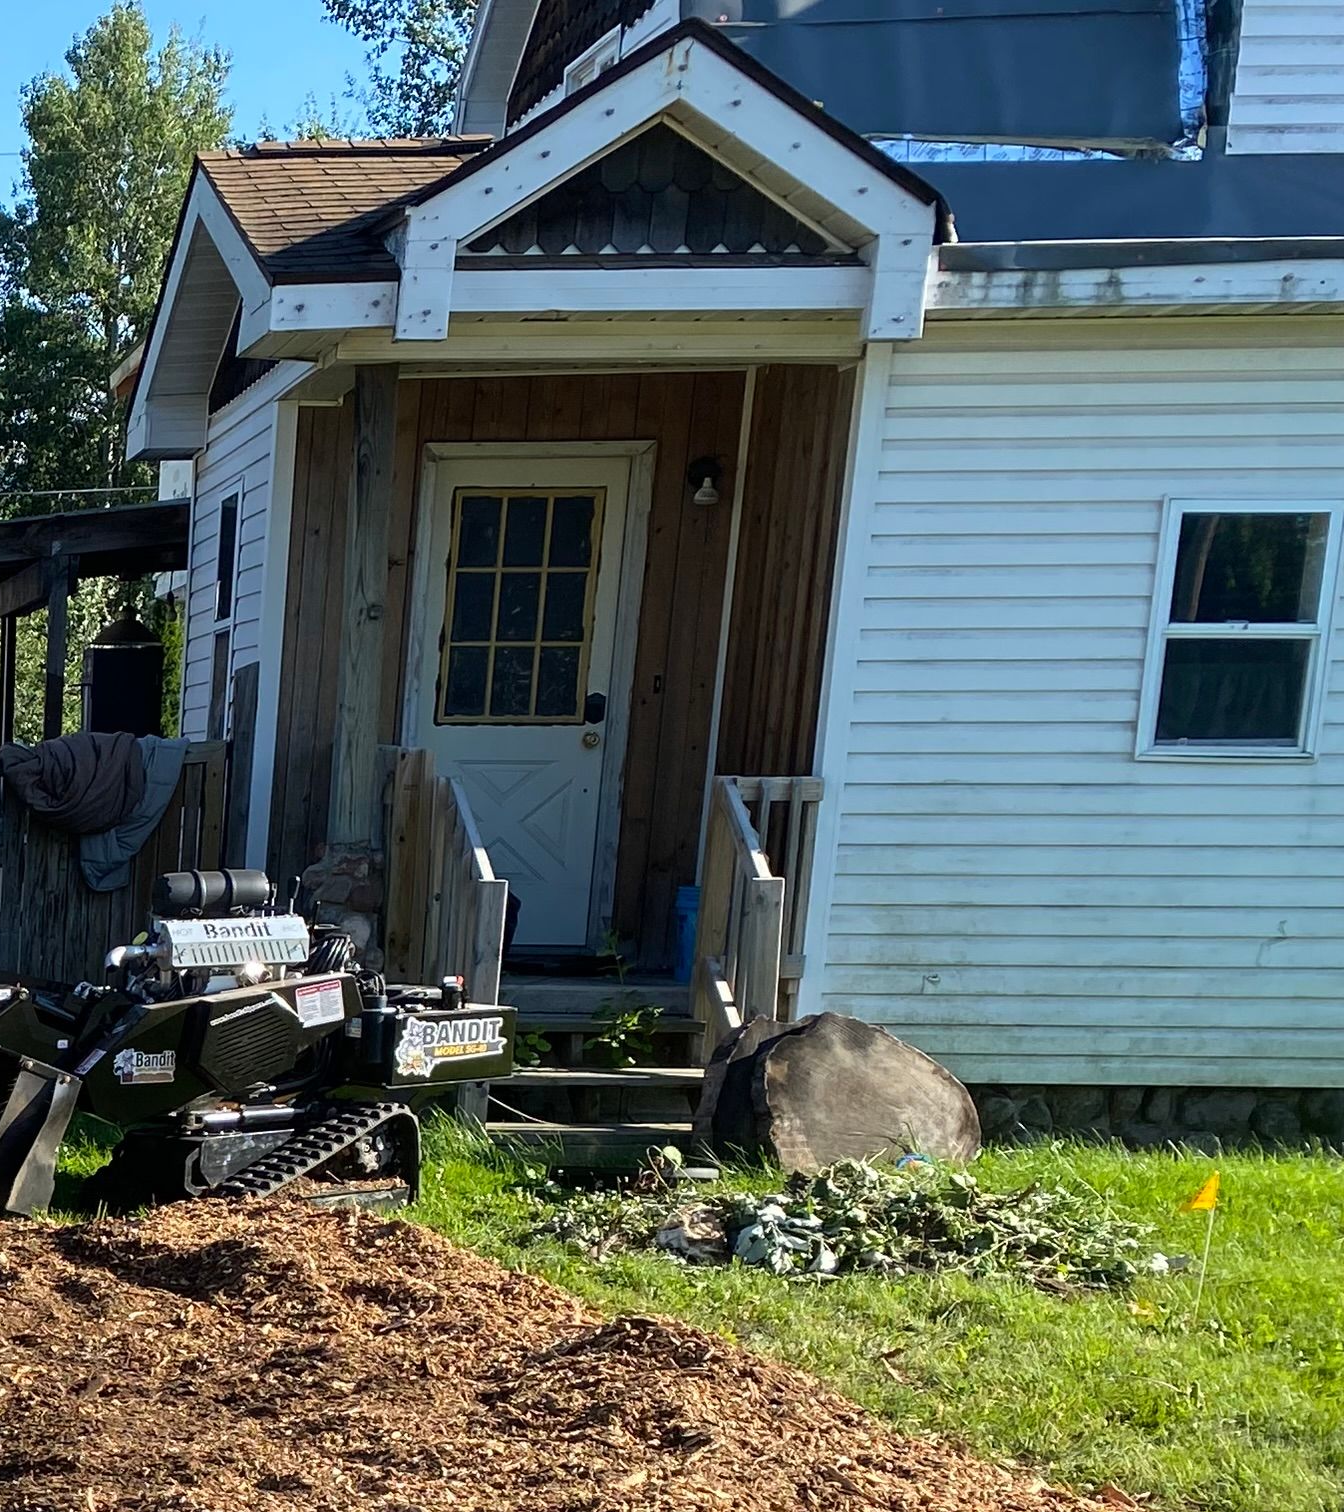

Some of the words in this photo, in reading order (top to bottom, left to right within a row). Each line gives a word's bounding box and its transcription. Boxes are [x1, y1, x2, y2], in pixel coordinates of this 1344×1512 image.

[203, 921, 273, 939] Bandit
[422, 1020, 501, 1045] BANDIT
[136, 1051, 175, 1067] Bandit
